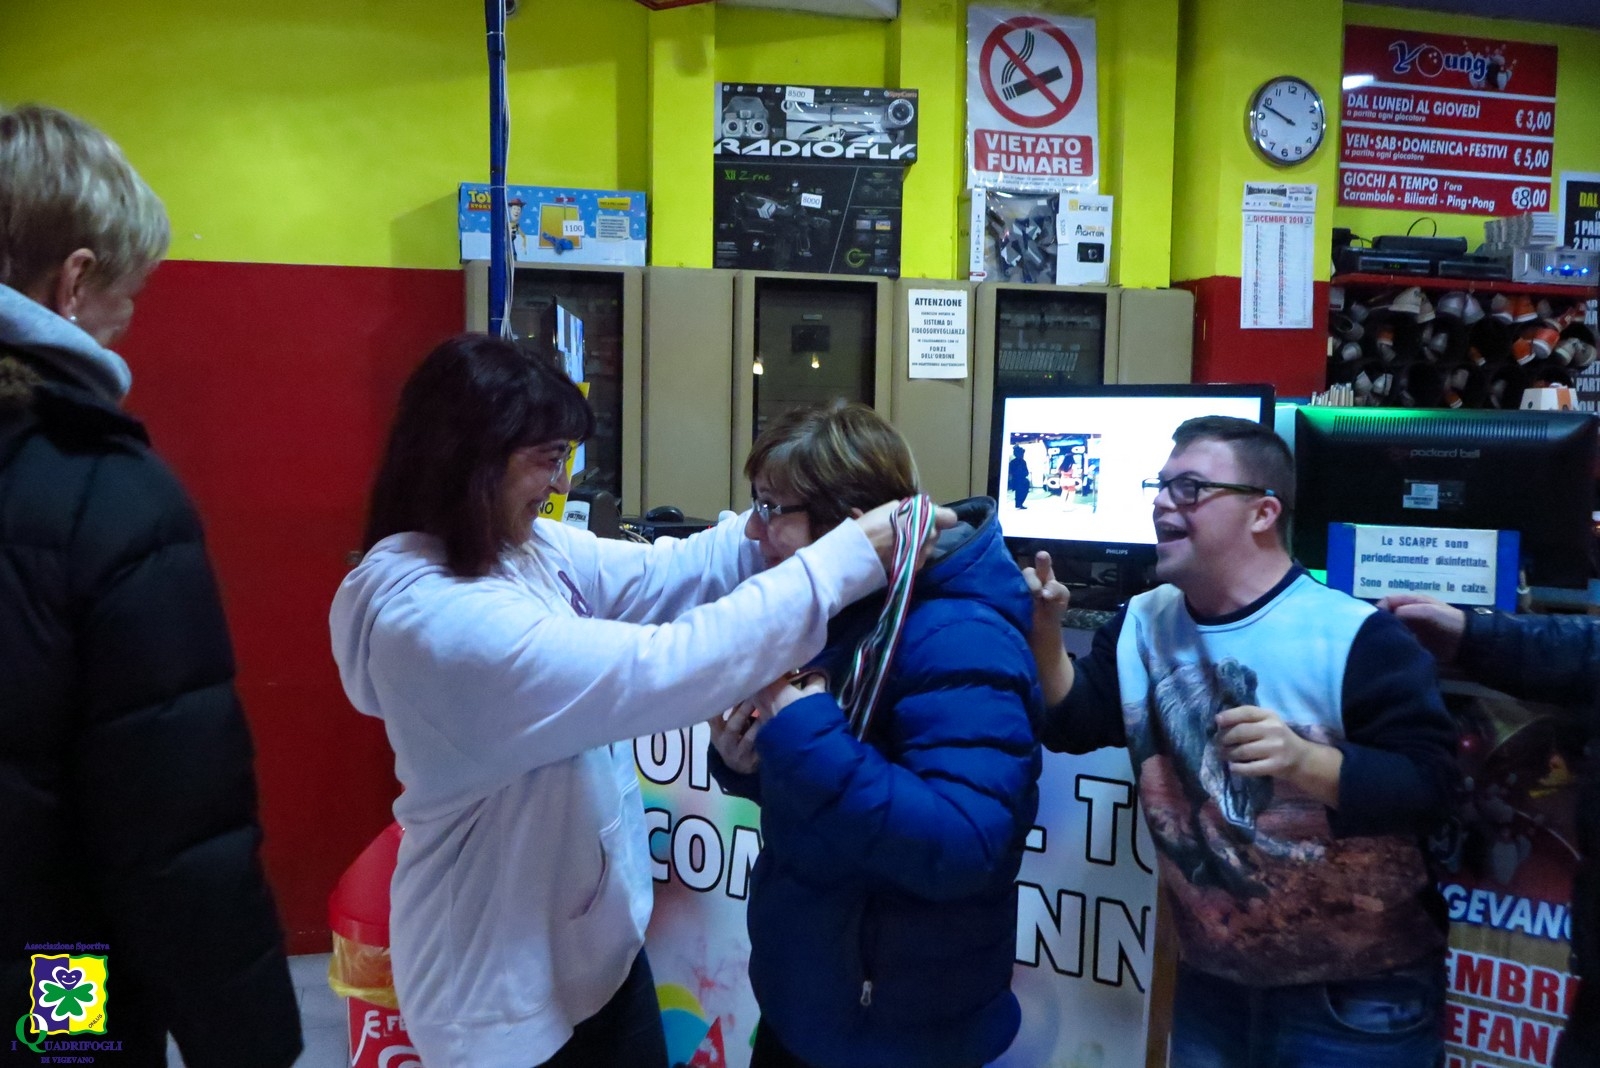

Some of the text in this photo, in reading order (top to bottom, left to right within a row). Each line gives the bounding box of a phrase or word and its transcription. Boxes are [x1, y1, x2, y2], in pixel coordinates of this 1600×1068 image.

[788, 89, 806, 98] 8500
[1347, 93, 1480, 118] DAL LUNEDÌ AL GIOVEDÌ
[1526, 110, 1551, 132] 3,00
[714, 138, 917, 160] RADIOFLY
[984, 132, 1081, 155] VIETATO
[987, 153, 1083, 174] FUMARE
[1523, 148, 1549, 170] 5,00
[1343, 171, 1386, 188] GIOCHI
[1388, 174, 1397, 189] A
[1401, 176, 1438, 191] TEMPO
[1404, 192, 1438, 205] Biliardi
[1253, 215, 1287, 224] DICEMBRE
[915, 298, 962, 307] ATTENZIONE
[911, 327, 966, 335] VIDEOSORVEGLIANZA
[1410, 448, 1458, 458] packard
[1382, 535, 1469, 549] Le SCARPE sono
[1361, 554, 1490, 568] periodicamente disinfettate.
[1360, 577, 1489, 594] Sono obbligatorie le calze.
[1437, 883, 1572, 940] GEVAN
